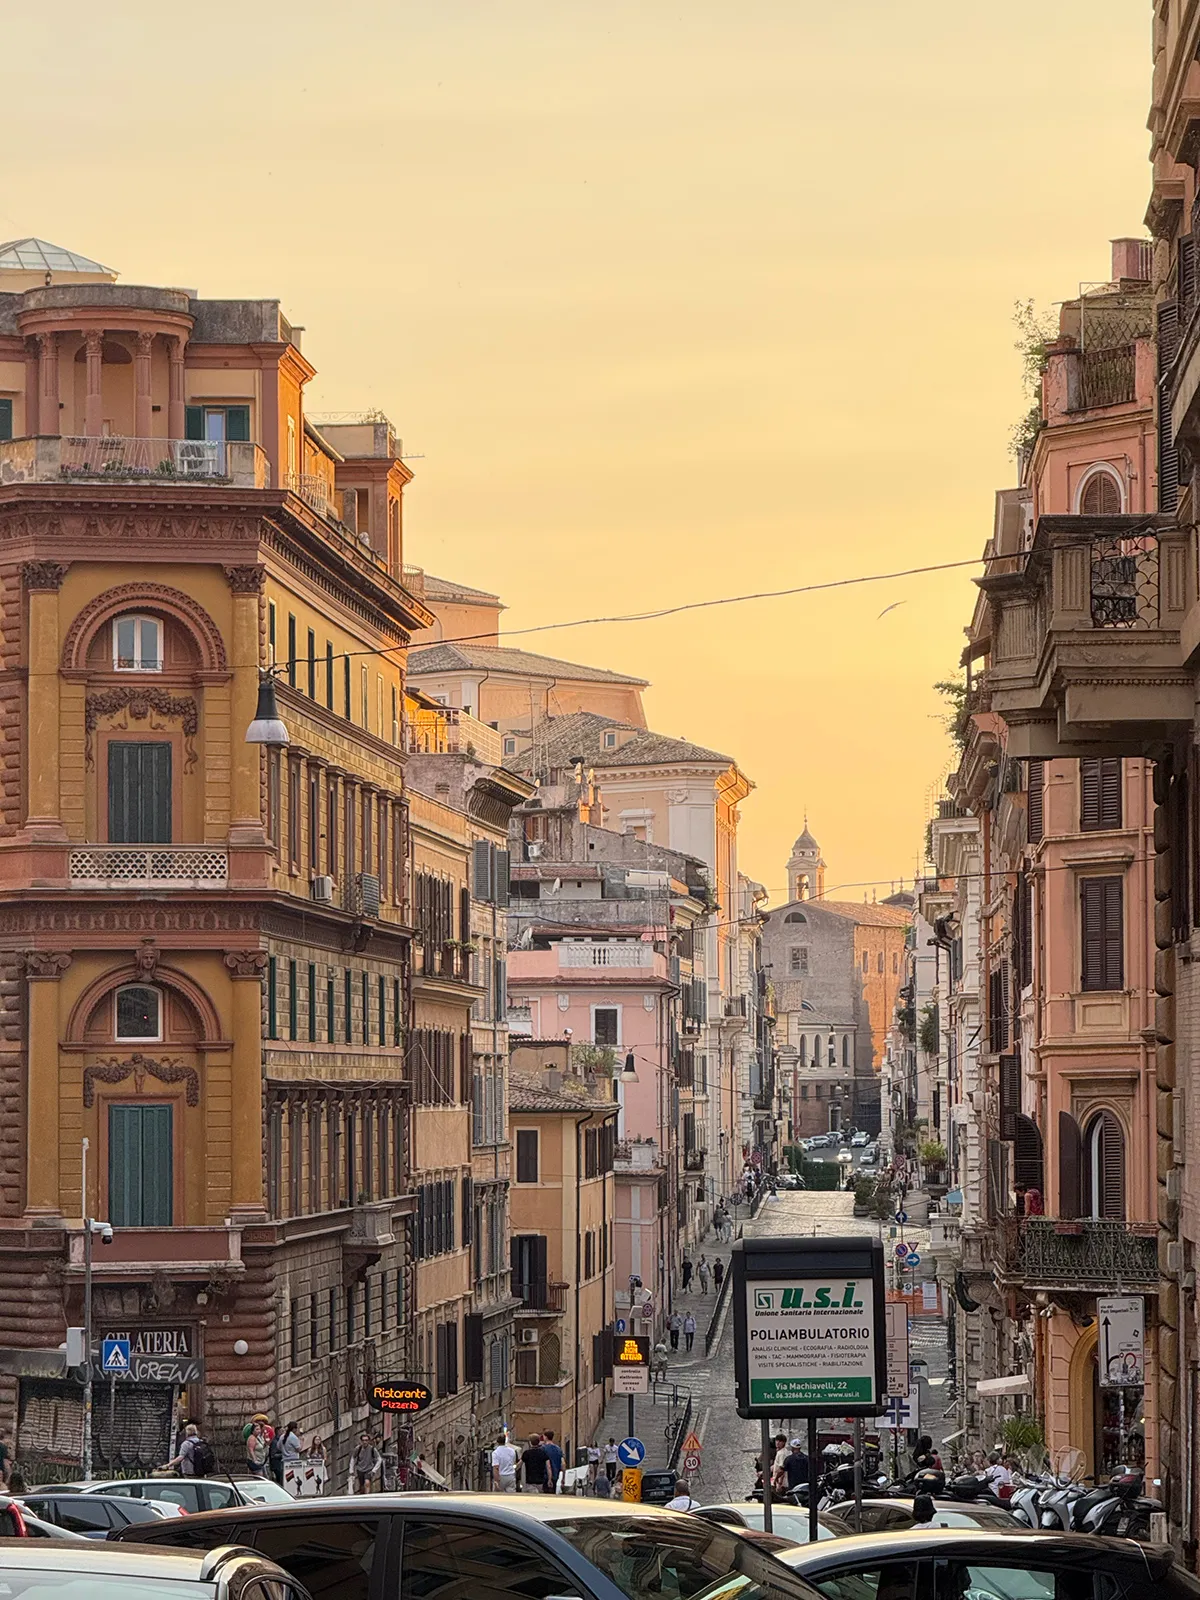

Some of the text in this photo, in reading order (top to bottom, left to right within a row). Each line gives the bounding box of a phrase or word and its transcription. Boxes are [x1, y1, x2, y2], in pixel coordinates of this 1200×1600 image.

[750, 1328, 870, 1340] POLIAMBULATORIO
[790, 1382, 836, 1390] Machiavelli,
[373, 1387, 427, 1398] Ristorante
[381, 1400, 419, 1409] Pizzeria
[688, 1459, 696, 1467] 30
